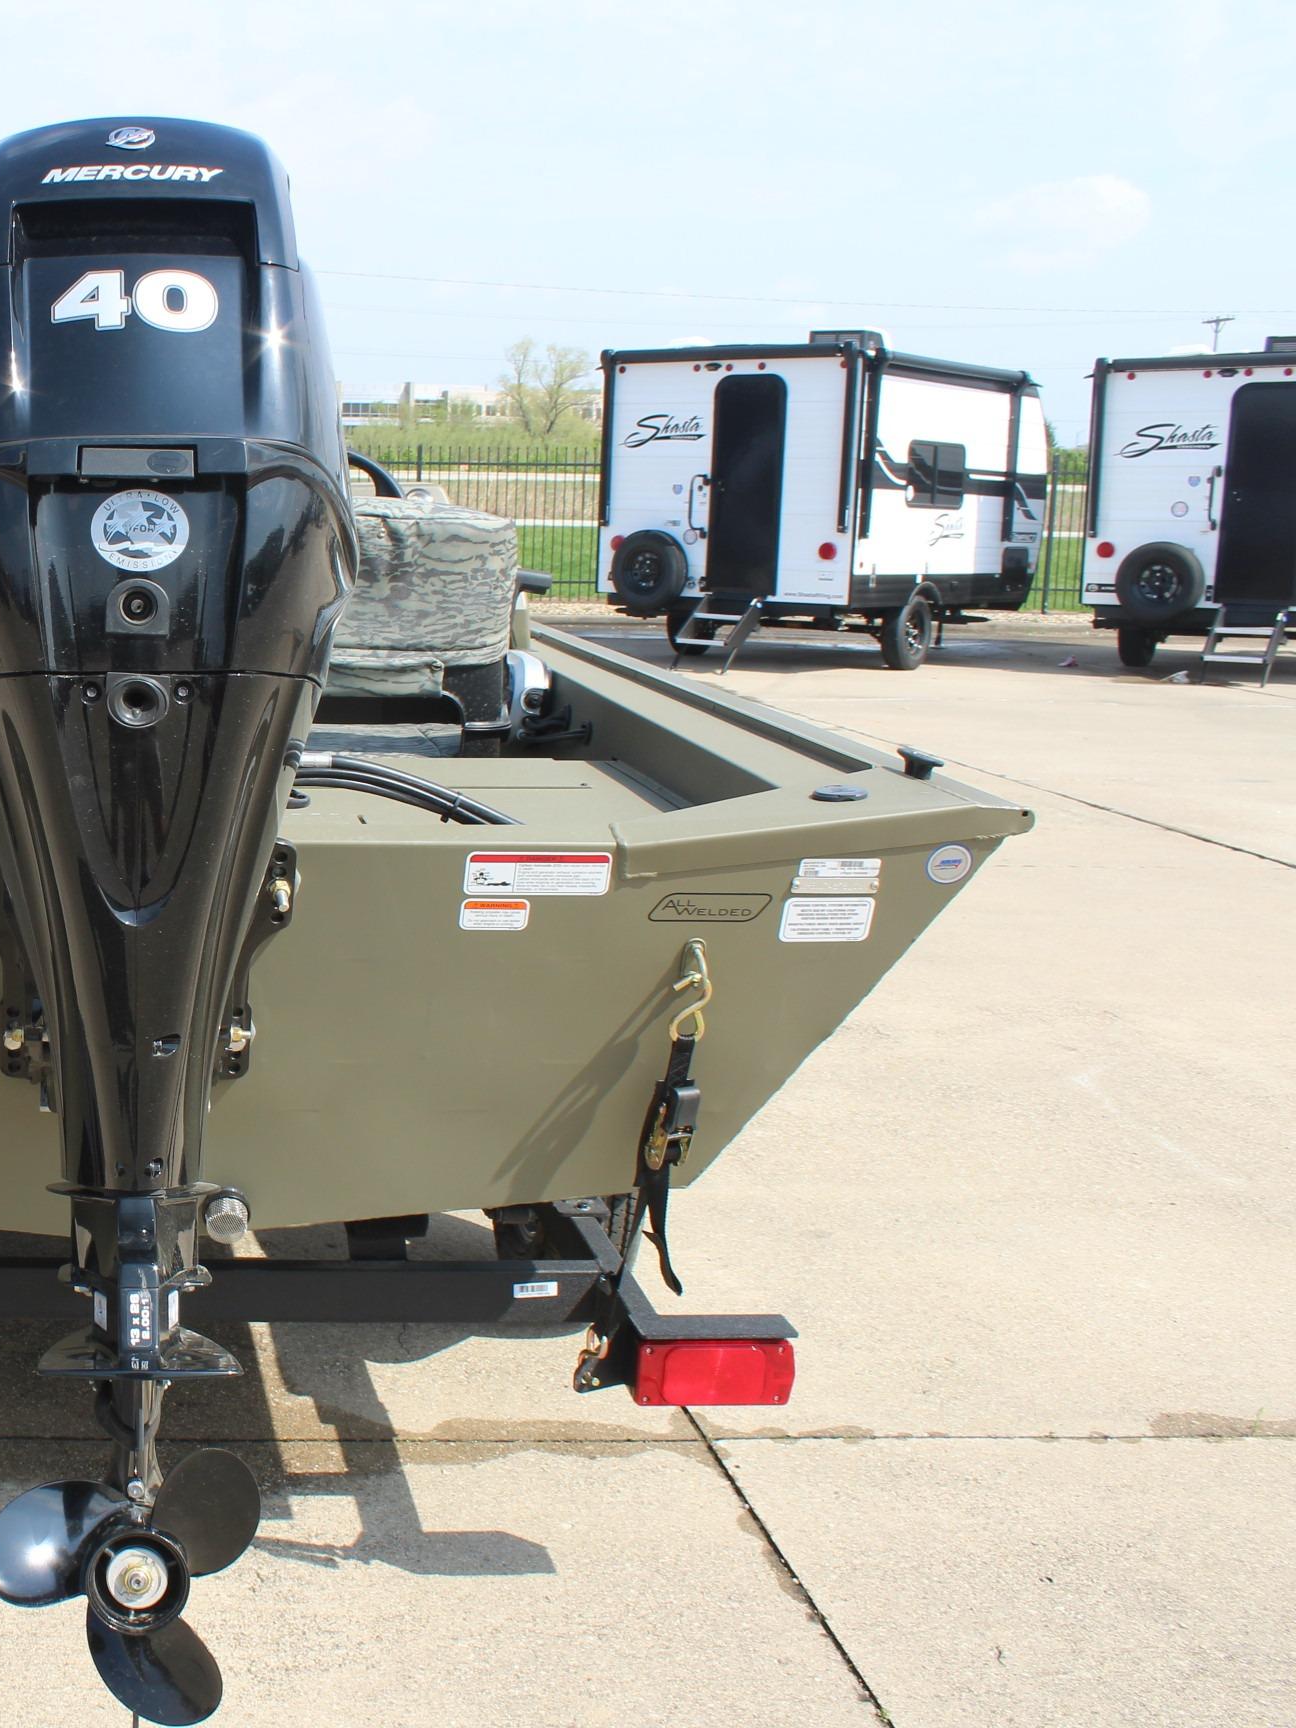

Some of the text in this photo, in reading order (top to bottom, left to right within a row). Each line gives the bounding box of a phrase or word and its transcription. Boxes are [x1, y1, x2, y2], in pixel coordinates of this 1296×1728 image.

[41, 164, 224, 184] MERCURY
[50, 269, 219, 332] 40
[621, 414, 705, 448] Shasta
[1116, 423, 1219, 459] Shasta
[154, 494, 180, 514] LOW
[662, 899, 697, 911] ALL
[676, 906, 752, 917] WELDED
